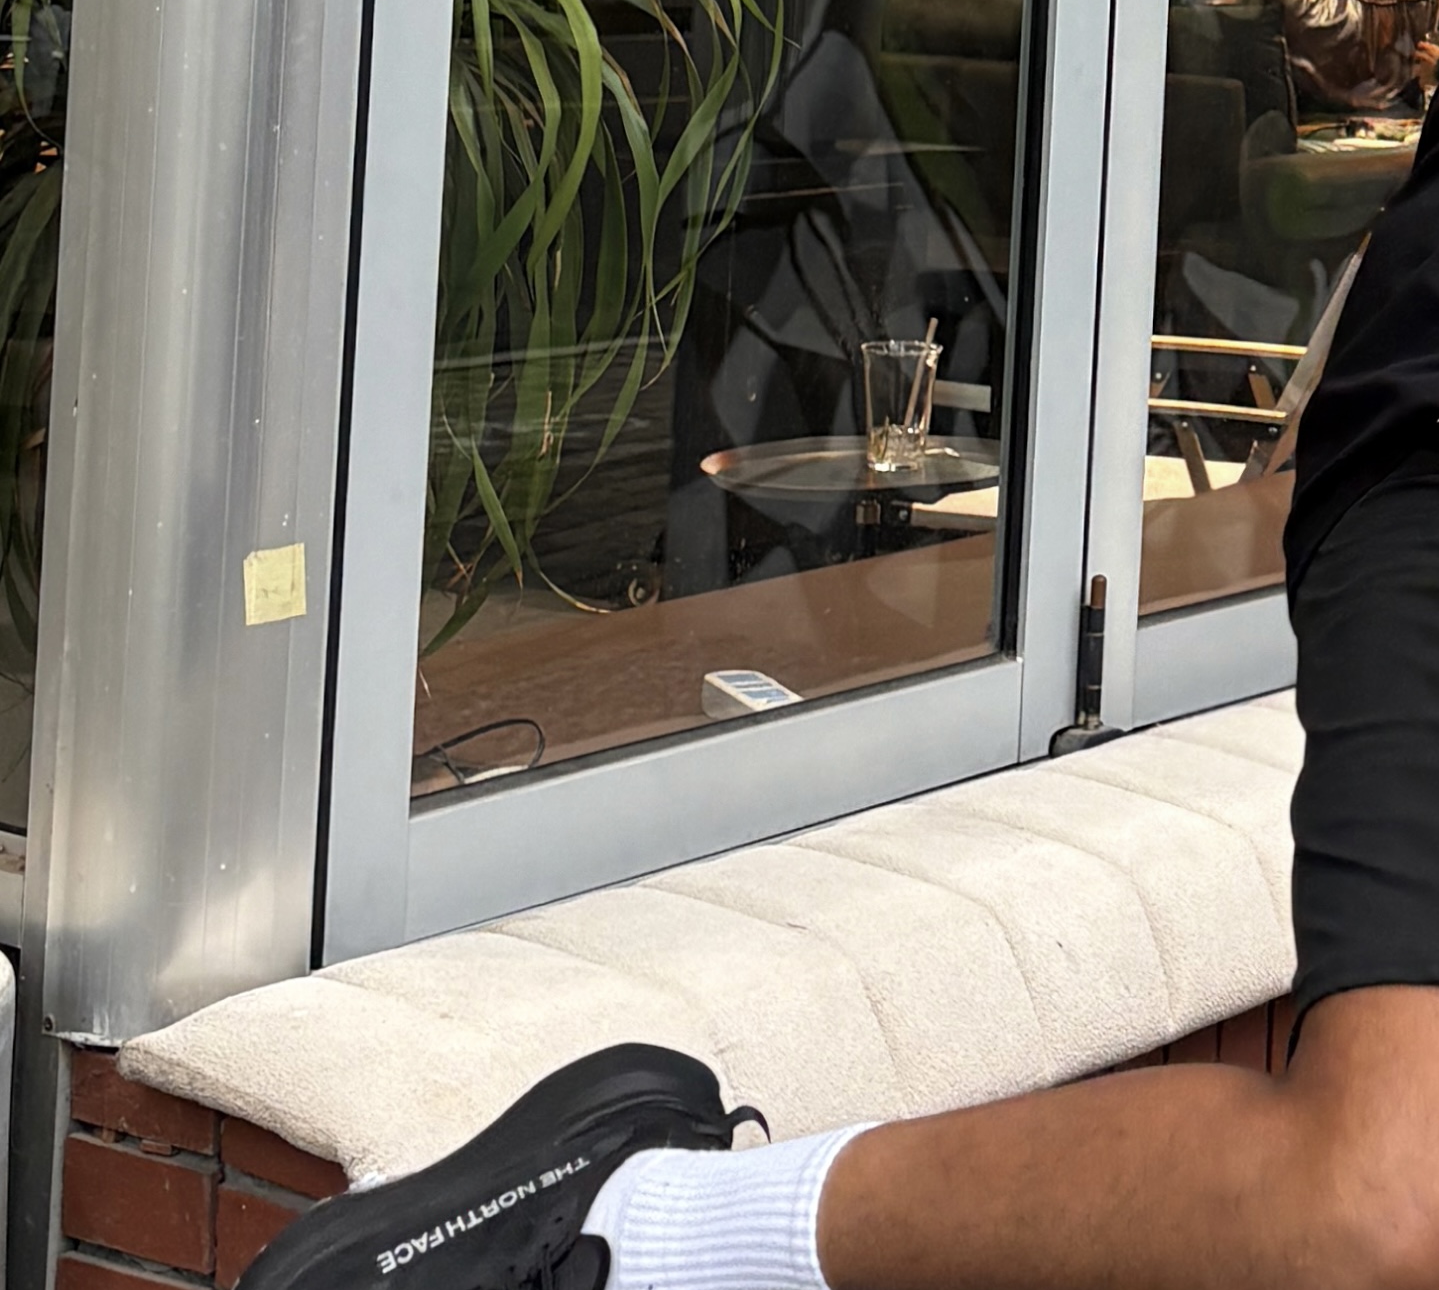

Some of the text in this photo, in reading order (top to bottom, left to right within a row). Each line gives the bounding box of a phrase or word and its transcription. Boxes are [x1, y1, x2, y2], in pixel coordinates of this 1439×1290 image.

[375, 1157, 591, 1274] THE NORTH FACE
